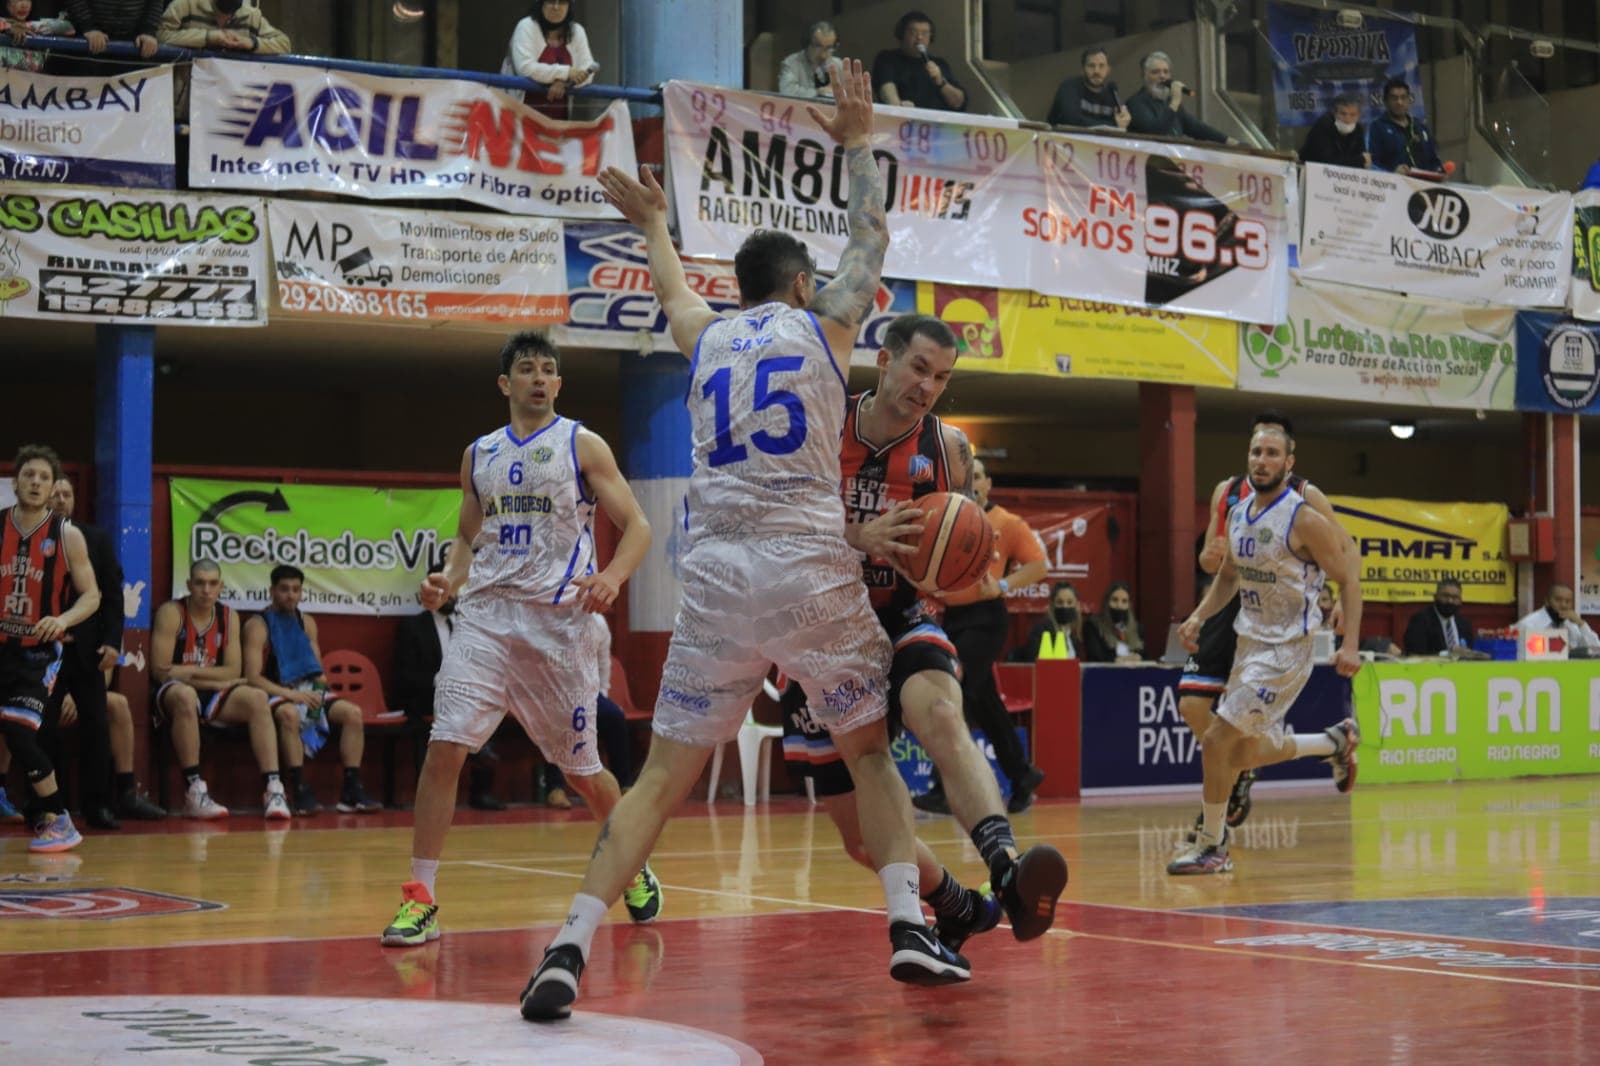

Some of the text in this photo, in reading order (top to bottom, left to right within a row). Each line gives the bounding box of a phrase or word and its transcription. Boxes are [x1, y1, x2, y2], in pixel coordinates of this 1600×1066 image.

[1292, 30, 1391, 64] DEPORTIVA
[243, 81, 615, 176] AGIL NET
[691, 90, 727, 126] 92
[760, 101, 795, 134] 94
[899, 120, 932, 154] 98
[963, 130, 1008, 164] 100
[1033, 134, 1076, 173] 102
[1095, 149, 1137, 185] 104
[1237, 172, 1273, 206] 108
[328, 163, 341, 181] y
[350, 161, 381, 183] TV
[390, 166, 426, 186] HD
[436, 171, 475, 189] por
[480, 172, 532, 199] Fibra
[48, 199, 259, 244] CASILLAS
[698, 195, 850, 237] RADIO VIEDMA
[1089, 184, 1136, 220] FM
[1143, 204, 1269, 271] 96.3
[285, 219, 353, 262] MP
[399, 221, 560, 243] Movimientos de Suelo
[1022, 206, 1134, 254] SOMOS
[400, 243, 483, 265] Transporte
[486, 248, 506, 264] de
[1145, 256, 1181, 276] MHZ
[197, 264, 249, 277] 239
[400, 266, 502, 286] Demoliciones
[1305, 349, 1336, 366] Para
[1339, 352, 1378, 370] Obras
[1445, 361, 1479, 377] Social
[702, 355, 808, 469] 15
[508, 460, 524, 486] 6
[1237, 537, 1256, 558] 10
[13, 577, 29, 594] 11
[1366, 567, 1507, 582] DE CONSTRUCCION
[357, 590, 376, 606] 42
[380, 591, 402, 607] s/n
[572, 706, 587, 732] 6
[1379, 677, 1561, 738] RN RN
[1379, 749, 1405, 766] RIO
[1407, 746, 1458, 765] NEGRO
[1487, 745, 1511, 760] RIO
[1512, 744, 1561, 760] NEGRO
